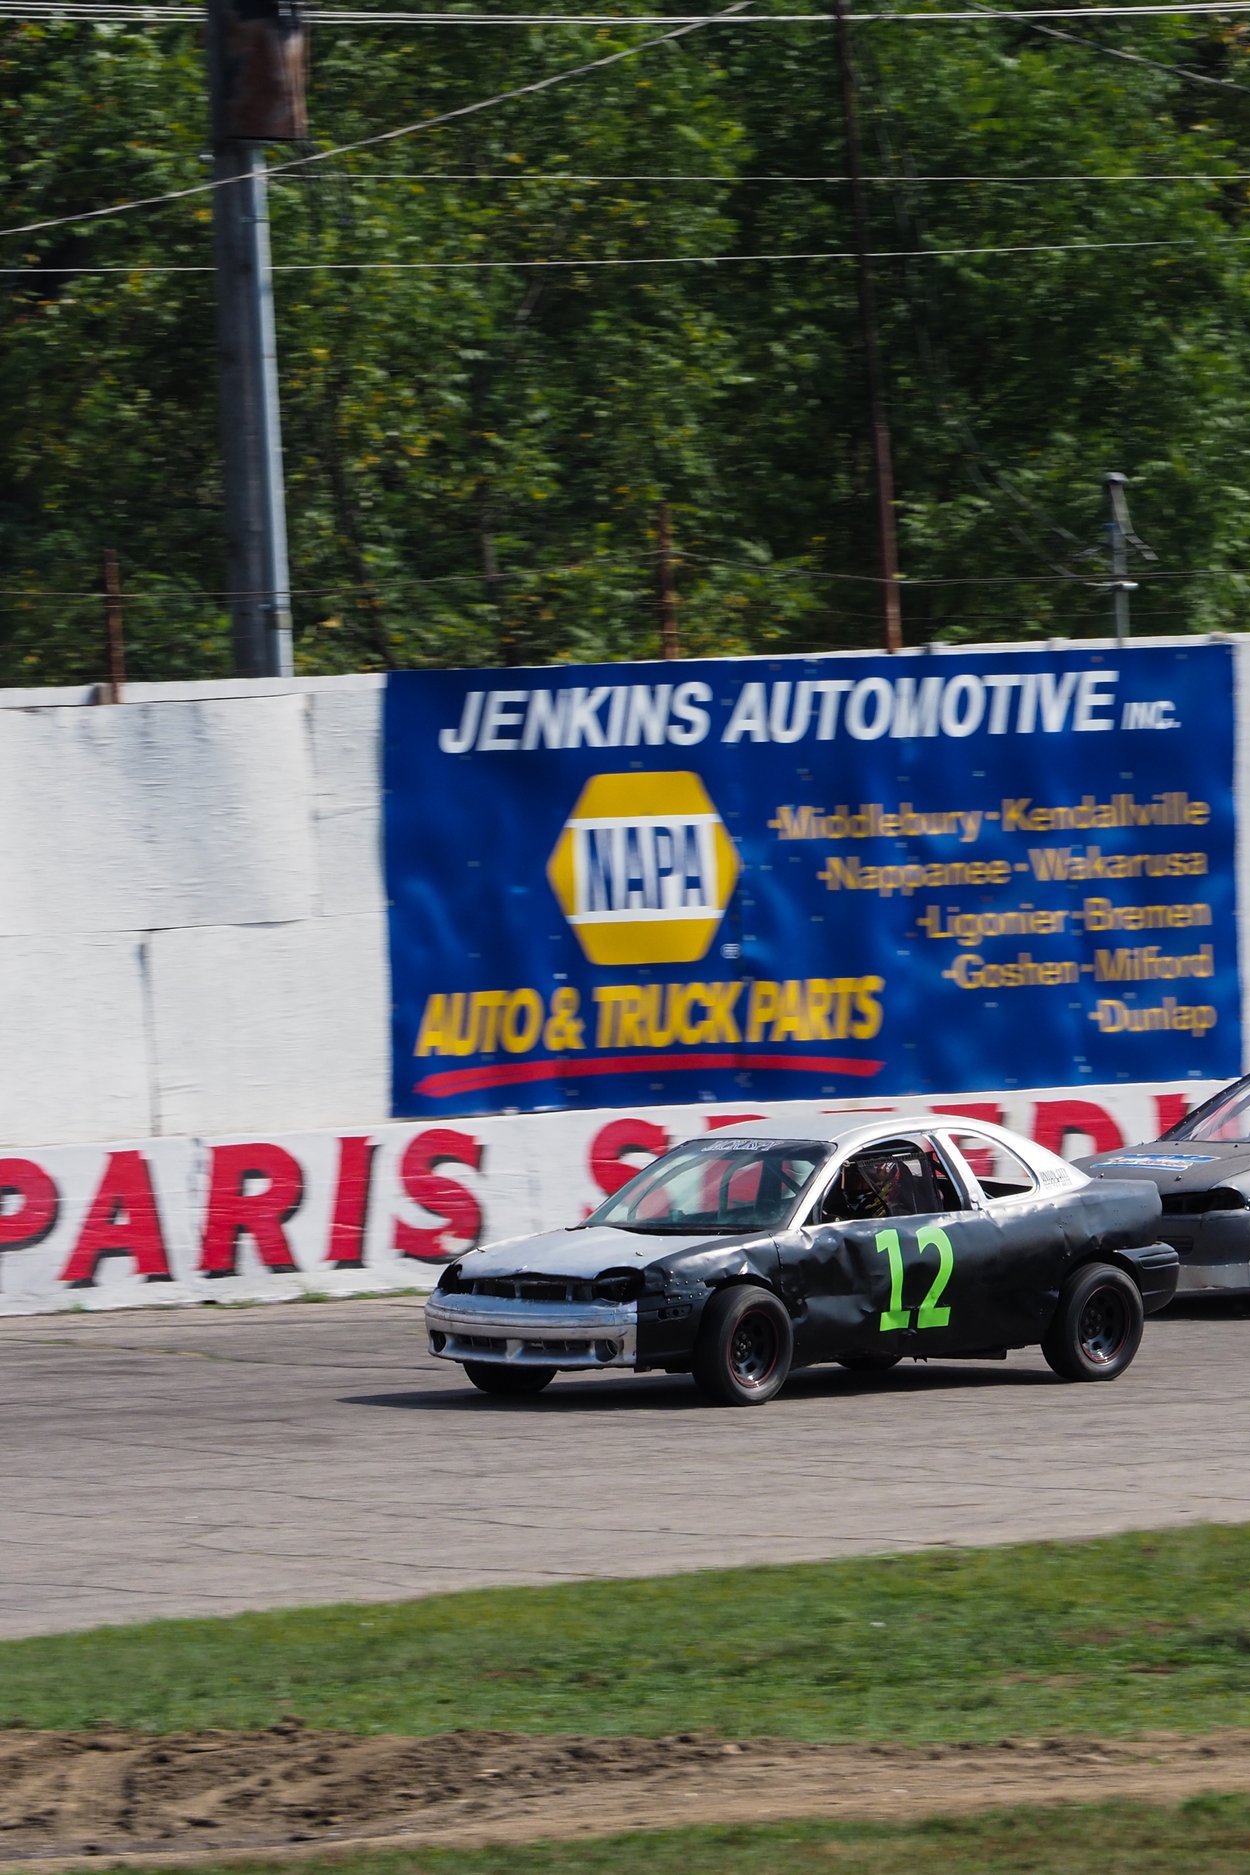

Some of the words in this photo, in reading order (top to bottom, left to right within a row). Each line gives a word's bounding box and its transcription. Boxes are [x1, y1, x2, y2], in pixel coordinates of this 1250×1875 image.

[438, 681, 713, 753] JENKINS
[720, 670, 1119, 743] AUTOMOTIVE
[1120, 700, 1181, 730] INC.
[777, 801, 984, 842] Middlebury
[1001, 791, 1211, 832] Kendallville
[582, 824, 710, 911] NAPA
[826, 856, 1011, 897] Nappanee
[1028, 845, 1208, 881] Wakarusa
[926, 904, 1070, 946] Ligonier
[1083, 897, 1212, 931] Bremen
[951, 953, 1080, 989] Goshen
[1094, 944, 1214, 982] Milford
[413, 988, 544, 1057] AUTO
[544, 986, 586, 1051] &
[592, 981, 743, 1049] TRUCK
[746, 975, 886, 1042] PARTS
[1097, 996, 1218, 1037] Dunlap
[875, 1225, 954, 1332] 12
